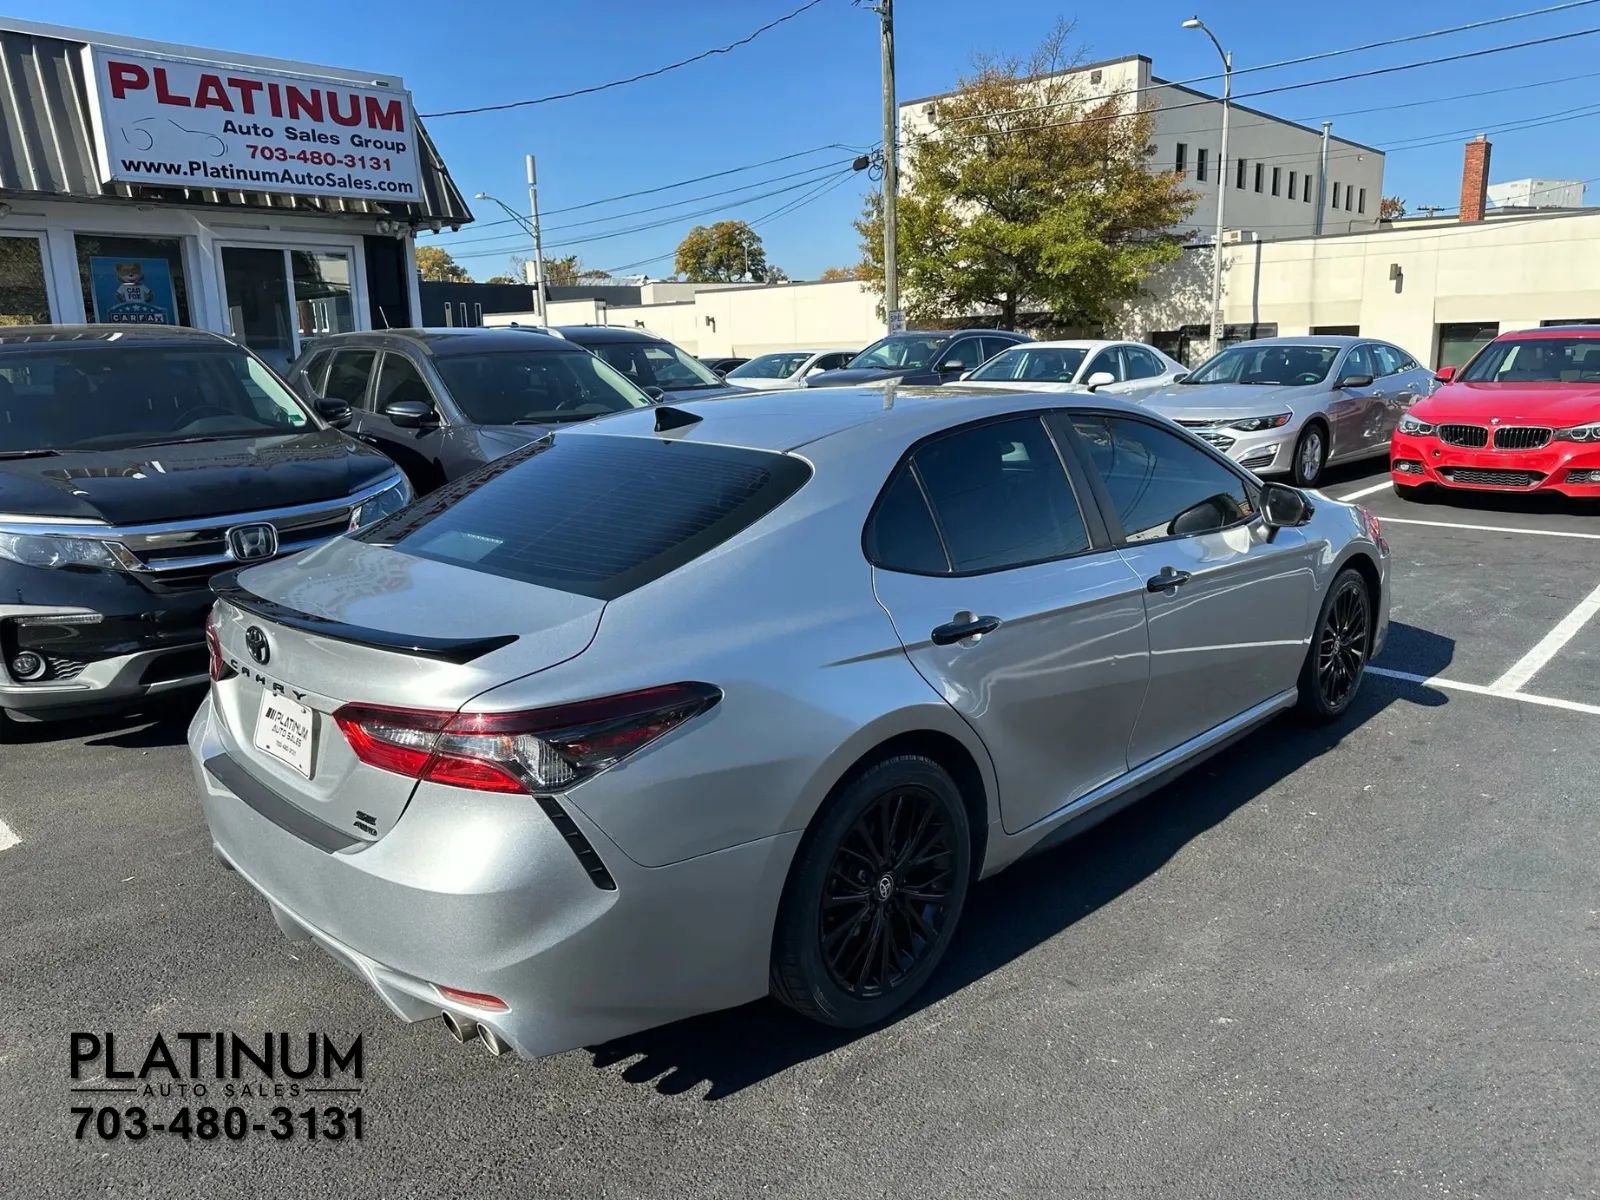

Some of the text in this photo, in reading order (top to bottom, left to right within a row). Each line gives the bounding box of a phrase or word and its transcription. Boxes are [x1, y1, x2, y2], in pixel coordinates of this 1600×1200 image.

[108, 61, 405, 132] PLATINUM
[223, 120, 407, 154] Auto Sales Group
[246, 144, 392, 172] 703-480-3131
[121, 159, 413, 193] www.PlatinumAutoSales.com
[112, 313, 164, 323] CARFAX
[230, 659, 307, 700] CAMRY
[272, 724, 287, 737] AUTO
[274, 711, 309, 740] PLATINUM
